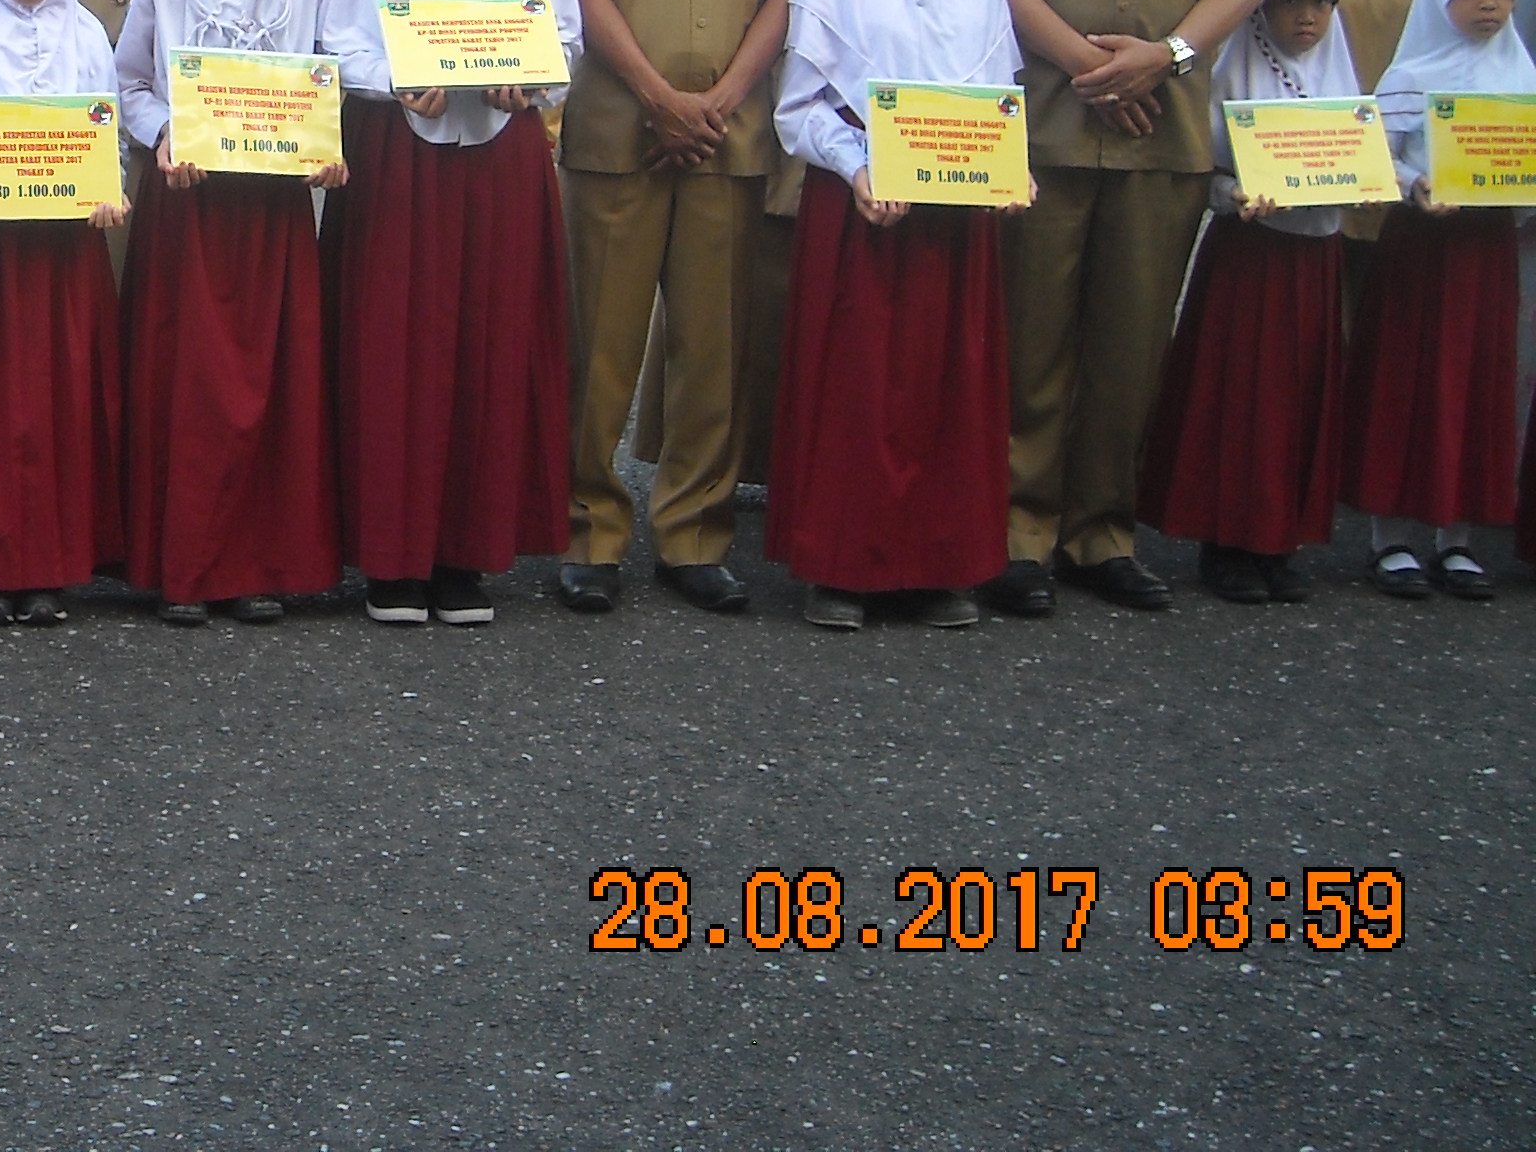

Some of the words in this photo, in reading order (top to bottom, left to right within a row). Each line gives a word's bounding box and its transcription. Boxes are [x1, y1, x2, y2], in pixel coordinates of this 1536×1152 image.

[440, 59, 455, 70] Rp
[464, 58, 520, 68] 1.100.000
[221, 138, 236, 152] Rp
[243, 139, 298, 153] 1.100.000
[917, 169, 931, 183] Rp
[938, 170, 988, 184] 1.100.000
[1307, 173, 1357, 186] 1.100.000
[18, 184, 76, 197] 1.100.000
